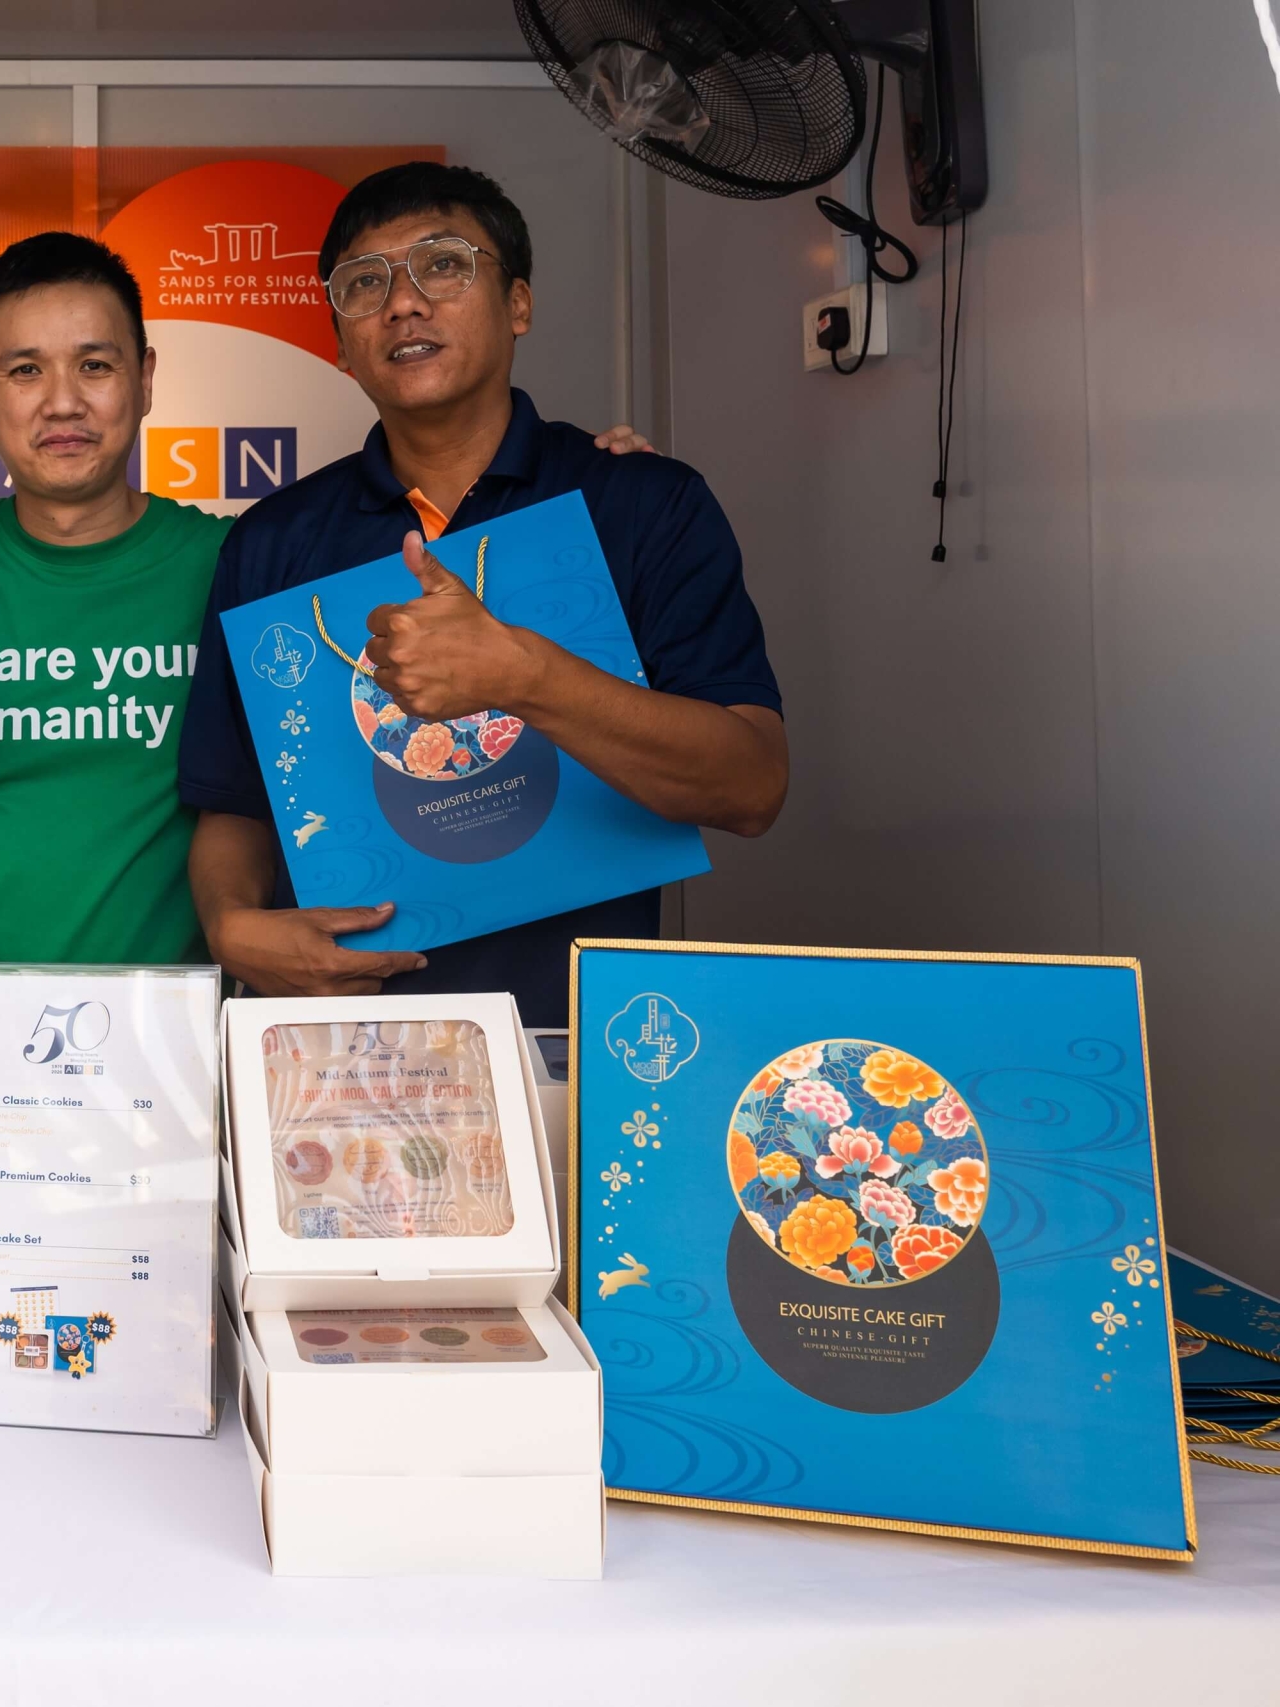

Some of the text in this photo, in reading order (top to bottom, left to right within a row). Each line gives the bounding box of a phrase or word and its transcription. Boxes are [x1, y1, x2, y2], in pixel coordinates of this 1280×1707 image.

[158, 275, 323, 288] SANDS FOR SINGA
[158, 292, 320, 306] CHARITY FESTIVAL
[92, 644, 199, 690] your
[417, 775, 527, 816] EXQUISITE CAKE GIFT
[22, 1000, 111, 1065] 50
[400, 1066, 449, 1078] Festival
[632, 1062, 660, 1070] MOON
[636, 1069, 659, 1077] CAKE
[2, 1095, 40, 1106] Classic
[42, 1096, 83, 1107] Cookies
[132, 1099, 153, 1109] $30
[10, 1112, 28, 1122] Chip
[0, 1170, 46, 1182] Premium
[48, 1172, 92, 1184] Cookies
[129, 1174, 151, 1186] $30
[23, 1234, 42, 1245] Set
[131, 1255, 150, 1264] $58
[131, 1272, 150, 1281] $88
[779, 1302, 946, 1329] EXQUISITE CAKE GIFT
[0, 1323, 18, 1335] $58
[91, 1322, 111, 1334] $88
[802, 1341, 926, 1359] SUPERB QUALITY EXQUISITE TASTE
[822, 1350, 907, 1364] AND INTENSE PLEASURE
